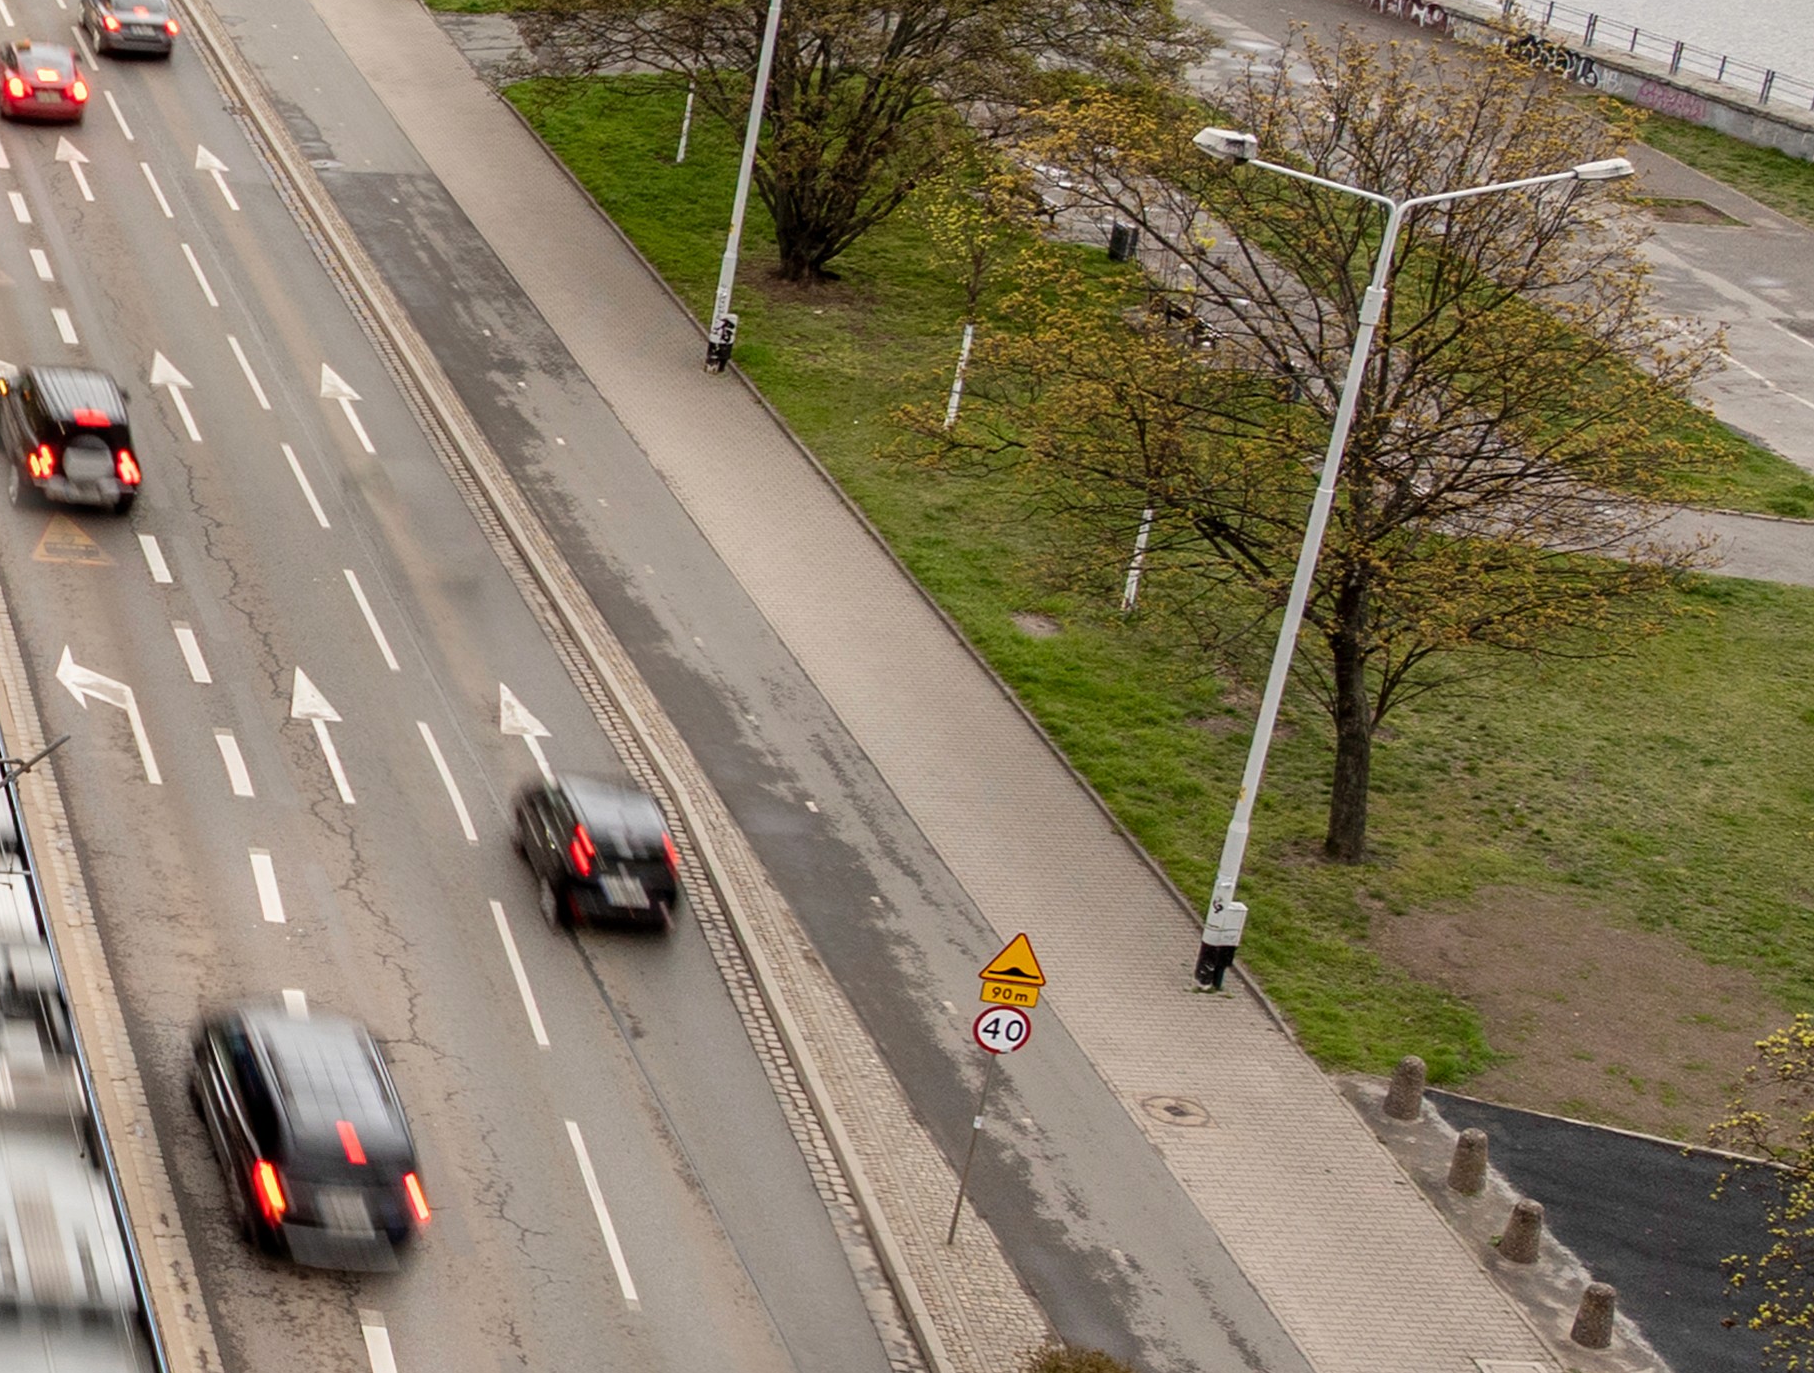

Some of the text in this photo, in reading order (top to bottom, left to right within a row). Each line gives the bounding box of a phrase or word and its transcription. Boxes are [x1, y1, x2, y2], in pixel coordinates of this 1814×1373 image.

[992, 986, 1028, 1002] 90 m
[982, 1017, 1024, 1042] 40
